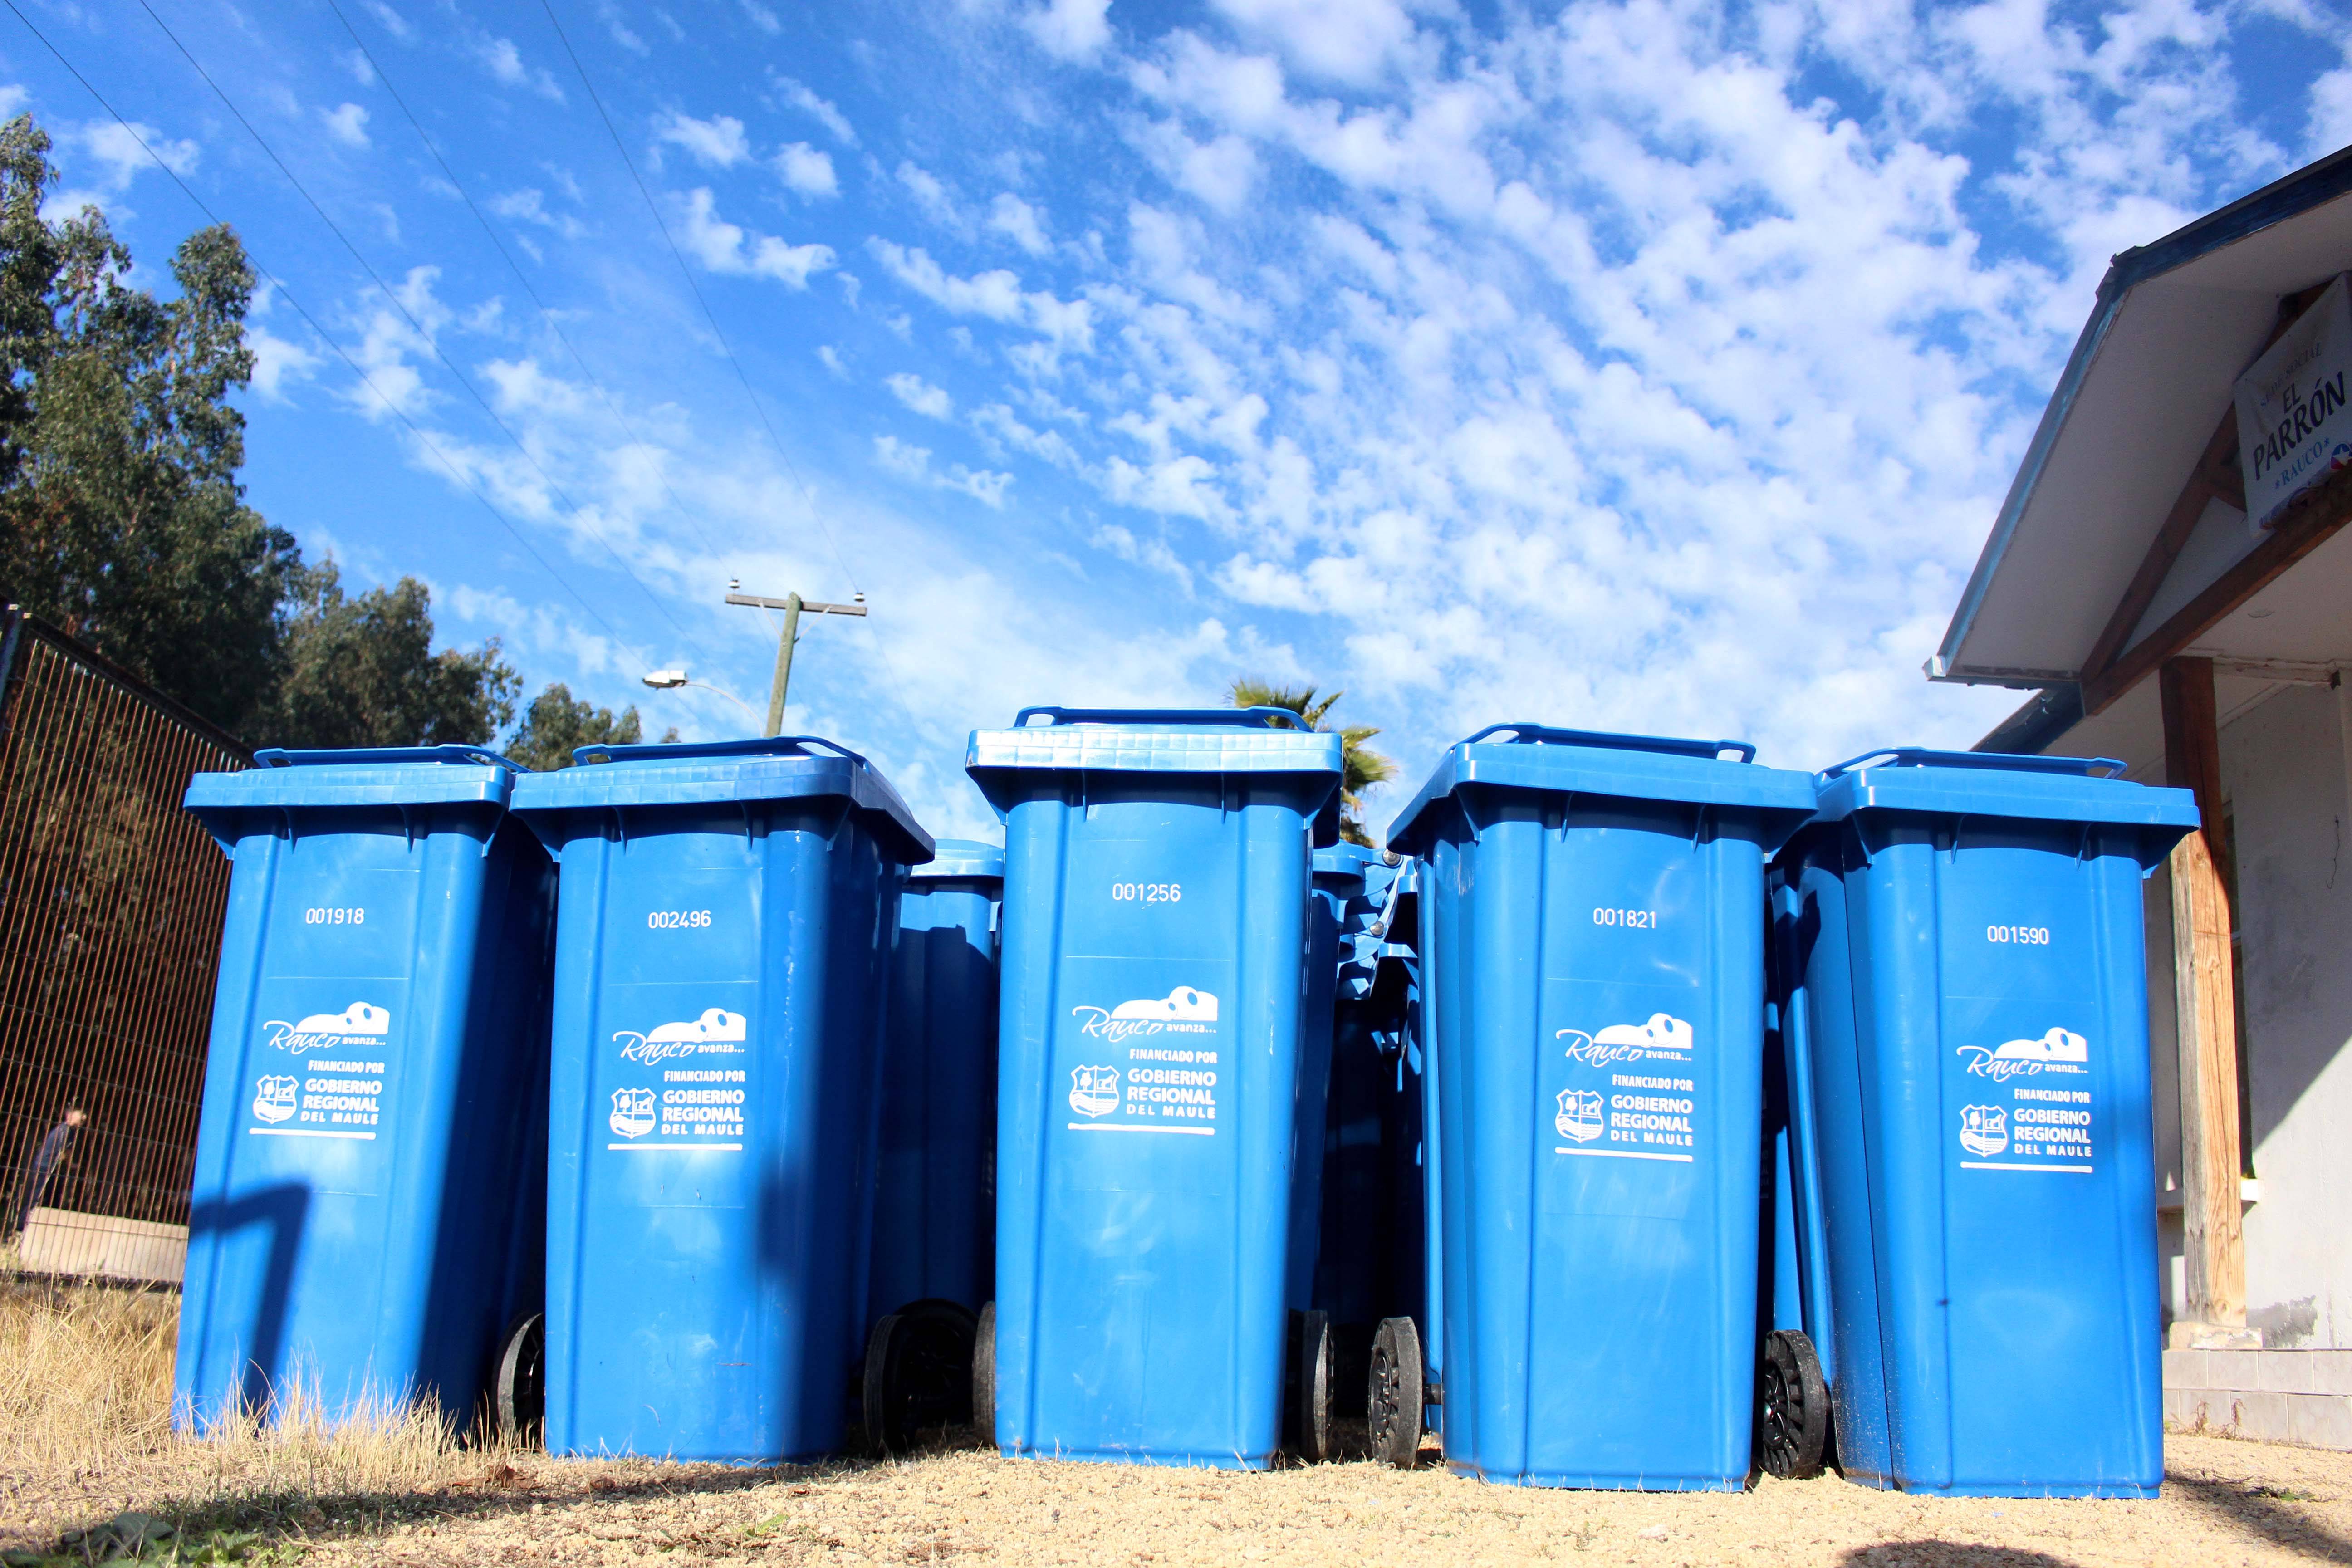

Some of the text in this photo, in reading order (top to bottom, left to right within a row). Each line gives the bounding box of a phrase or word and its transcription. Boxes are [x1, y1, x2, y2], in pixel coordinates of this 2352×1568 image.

[2283, 383, 2302, 414] EL
[2253, 371, 2346, 481] PARRÓN
[1112, 883, 1181, 902] 001256
[305, 908, 364, 925] 001918
[648, 910, 711, 929] 002496
[1593, 907, 1656, 929] 001821
[1987, 925, 2049, 945] 001590
[1072, 1005, 1164, 1042] Rauco
[263, 1020, 341, 1055] Rauco
[612, 1031, 696, 1066] Rauco
[1129, 1048, 1217, 1064] FINANCIADO POR
[1555, 1029, 1643, 1068] Rauco
[308, 1059, 385, 1074] FINANCIADO POR
[1956, 1045, 2043, 1082] Rauco
[664, 1070, 745, 1082] FINANCIADO POR
[1128, 1068, 1217, 1088] GOBIERNO
[1612, 1074, 1694, 1092] FINANCIADO POR
[304, 1078, 382, 1095] GOBIERNO
[2014, 1088, 2091, 1103] FINANCIADO POR
[302, 1095, 379, 1112] REGIONAL
[662, 1089, 745, 1104] GOBIERNO
[1127, 1086, 1216, 1106] REGIONAL
[1611, 1094, 1693, 1115] GOBIERNO
[300, 1112, 378, 1125] DEL MAULE
[662, 1107, 744, 1122] REGIONAL
[1126, 1103, 1215, 1119] DEL MAULE
[2014, 1108, 2091, 1126] GOBIERNO
[661, 1124, 743, 1135] DEL MAULE
[1611, 1112, 1693, 1134] REGIONAL
[1611, 1131, 1693, 1147] DEL MAULE
[2014, 1126, 2091, 1144] REGIONAL
[2014, 1143, 2092, 1157] DEL MAULE
